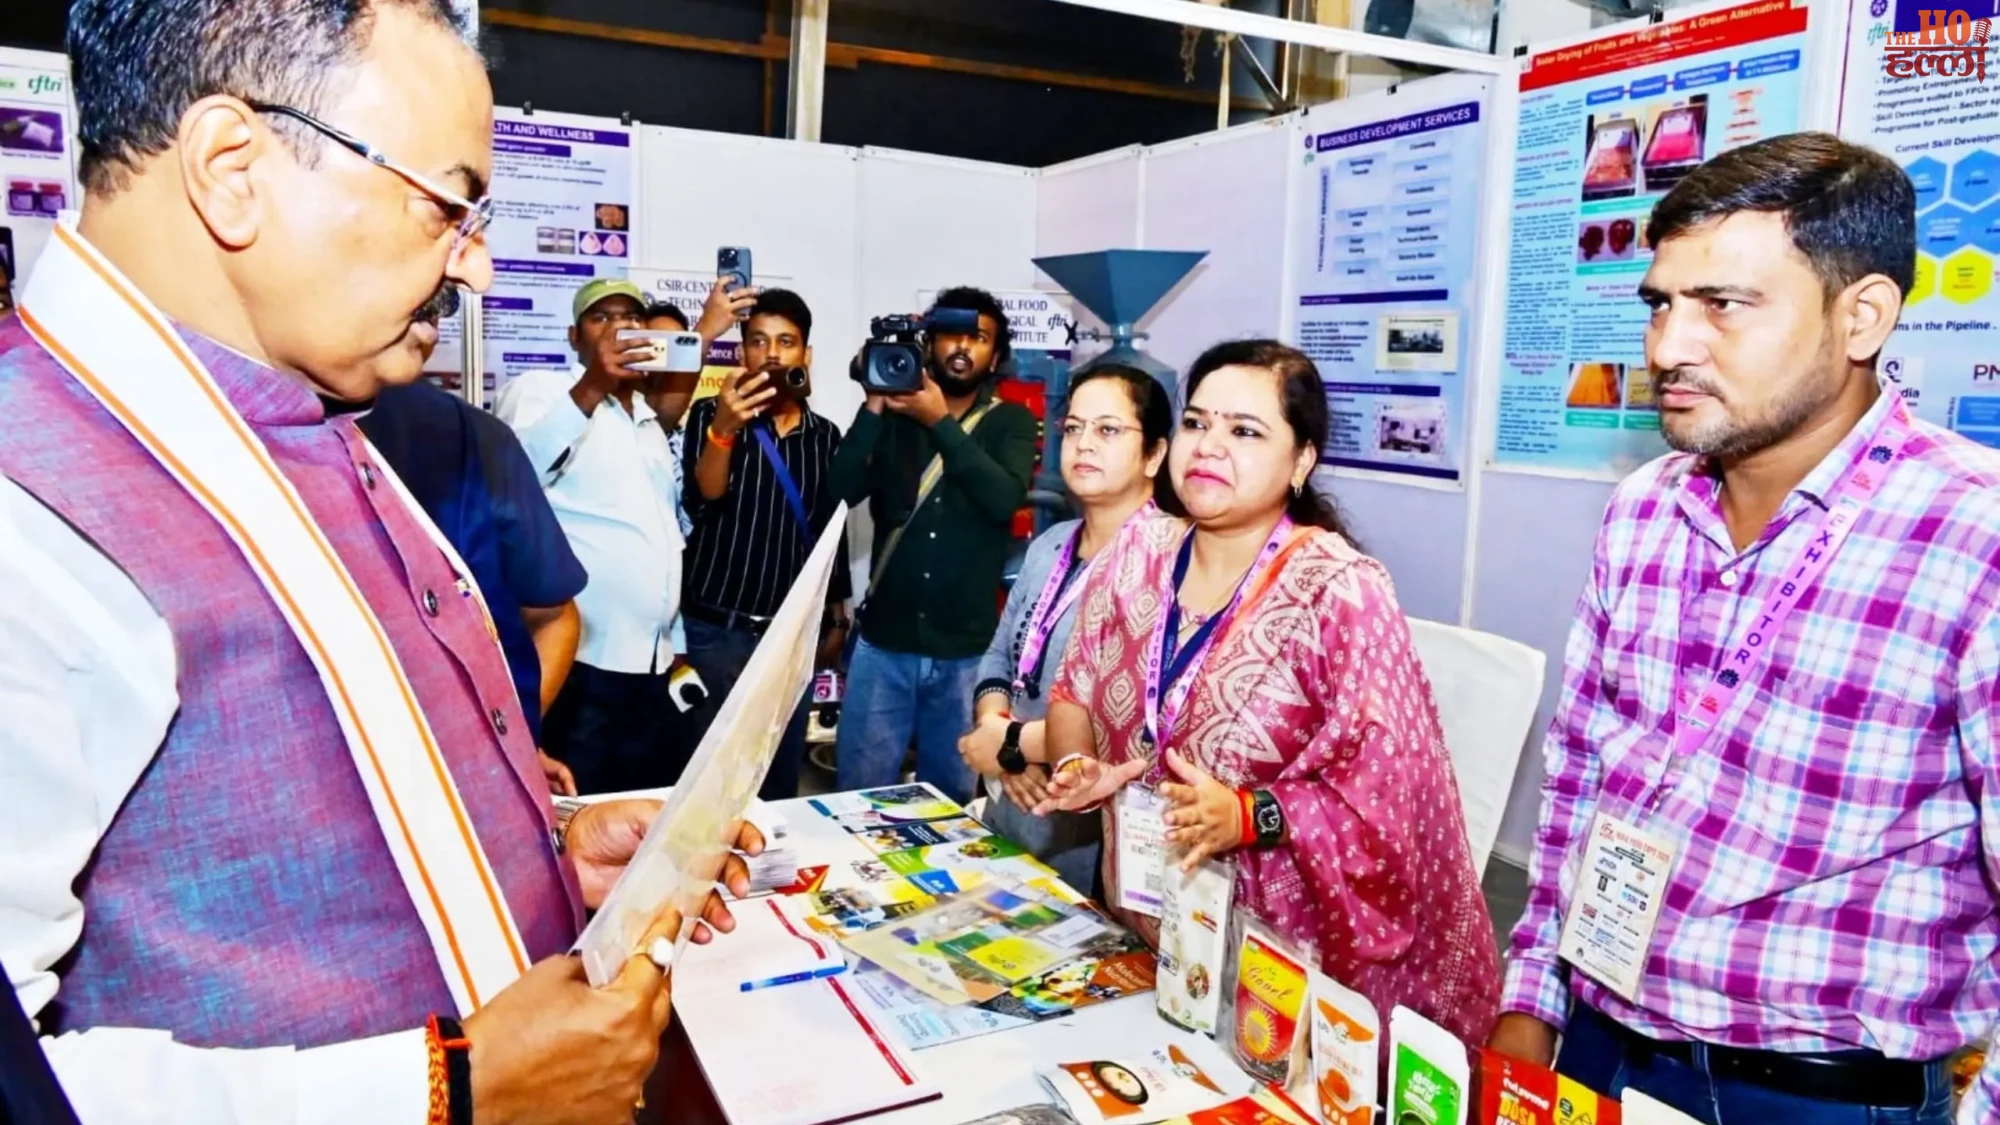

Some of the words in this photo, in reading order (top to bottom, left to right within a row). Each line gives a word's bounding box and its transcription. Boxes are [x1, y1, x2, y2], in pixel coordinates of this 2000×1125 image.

[28, 75, 63, 95] cftri
[513, 124, 536, 135] AND
[537, 126, 595, 142] WELLNESS
[1319, 132, 1359, 149] BUSINESS
[1360, 117, 1422, 140] DEVELOPMENT
[1424, 106, 1471, 128] SERVICES
[1018, 299, 1048, 311] FOOD
[1912, 320, 1922, 331] in
[1925, 321, 1942, 331] the
[1945, 320, 1990, 332] Pipeline
[1734, 512, 1848, 664] EXHIBITOR
